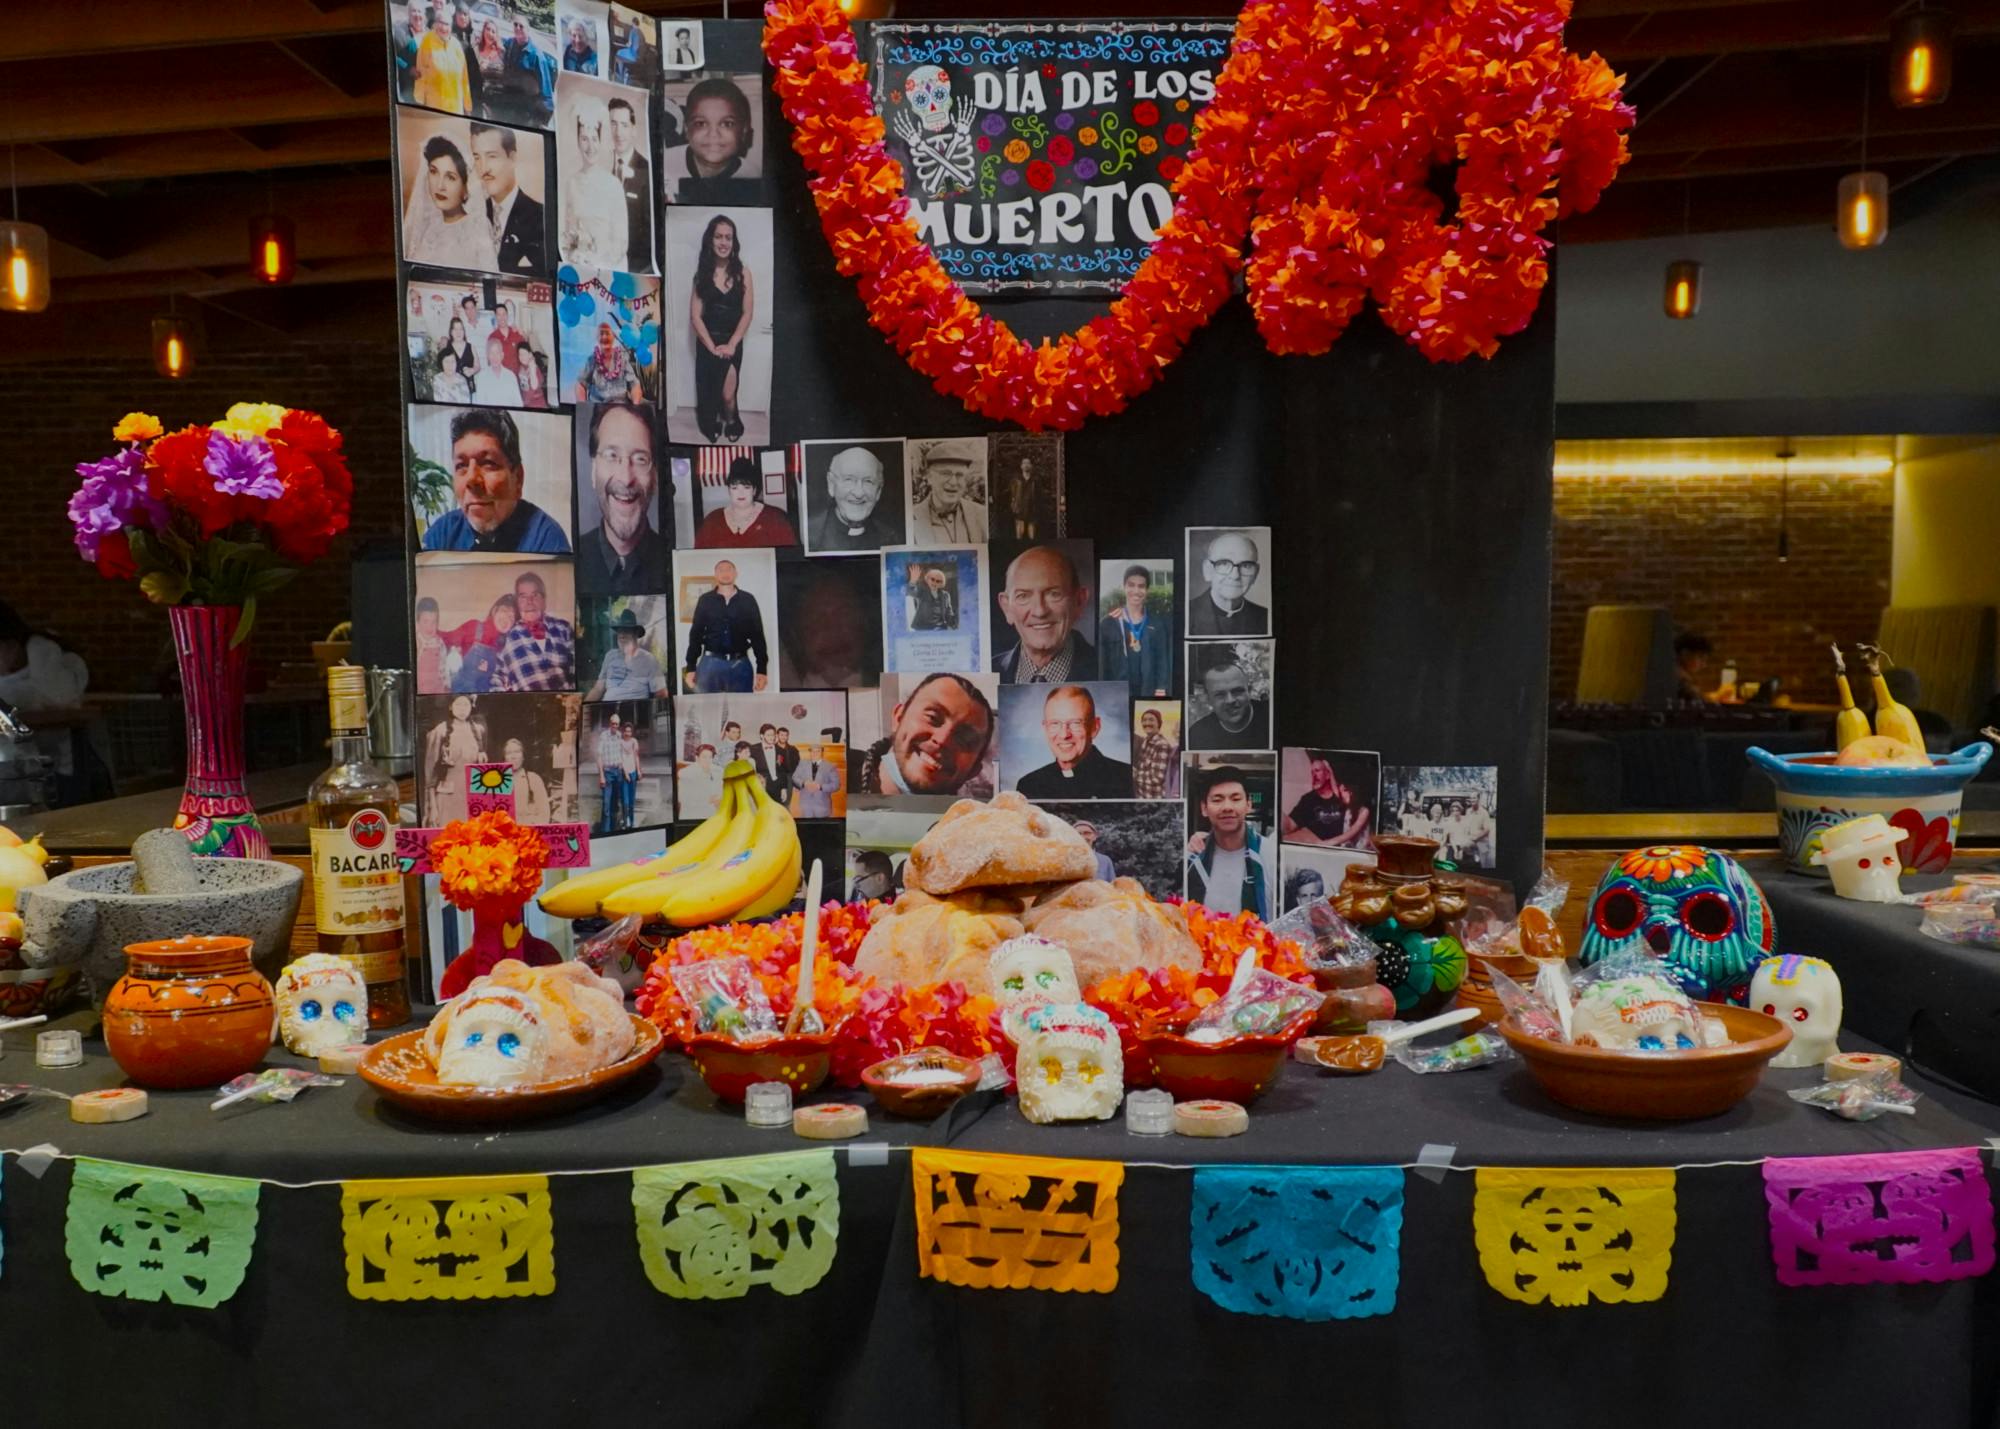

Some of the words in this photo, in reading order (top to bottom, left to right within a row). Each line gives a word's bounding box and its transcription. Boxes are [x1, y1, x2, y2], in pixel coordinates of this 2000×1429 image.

[973, 66, 1047, 114] DÍA
[1061, 71, 1119, 110] DE
[1133, 69, 1215, 101] LOS
[908, 181, 1174, 246] MUERTO
[329, 852, 398, 873] BACARD
